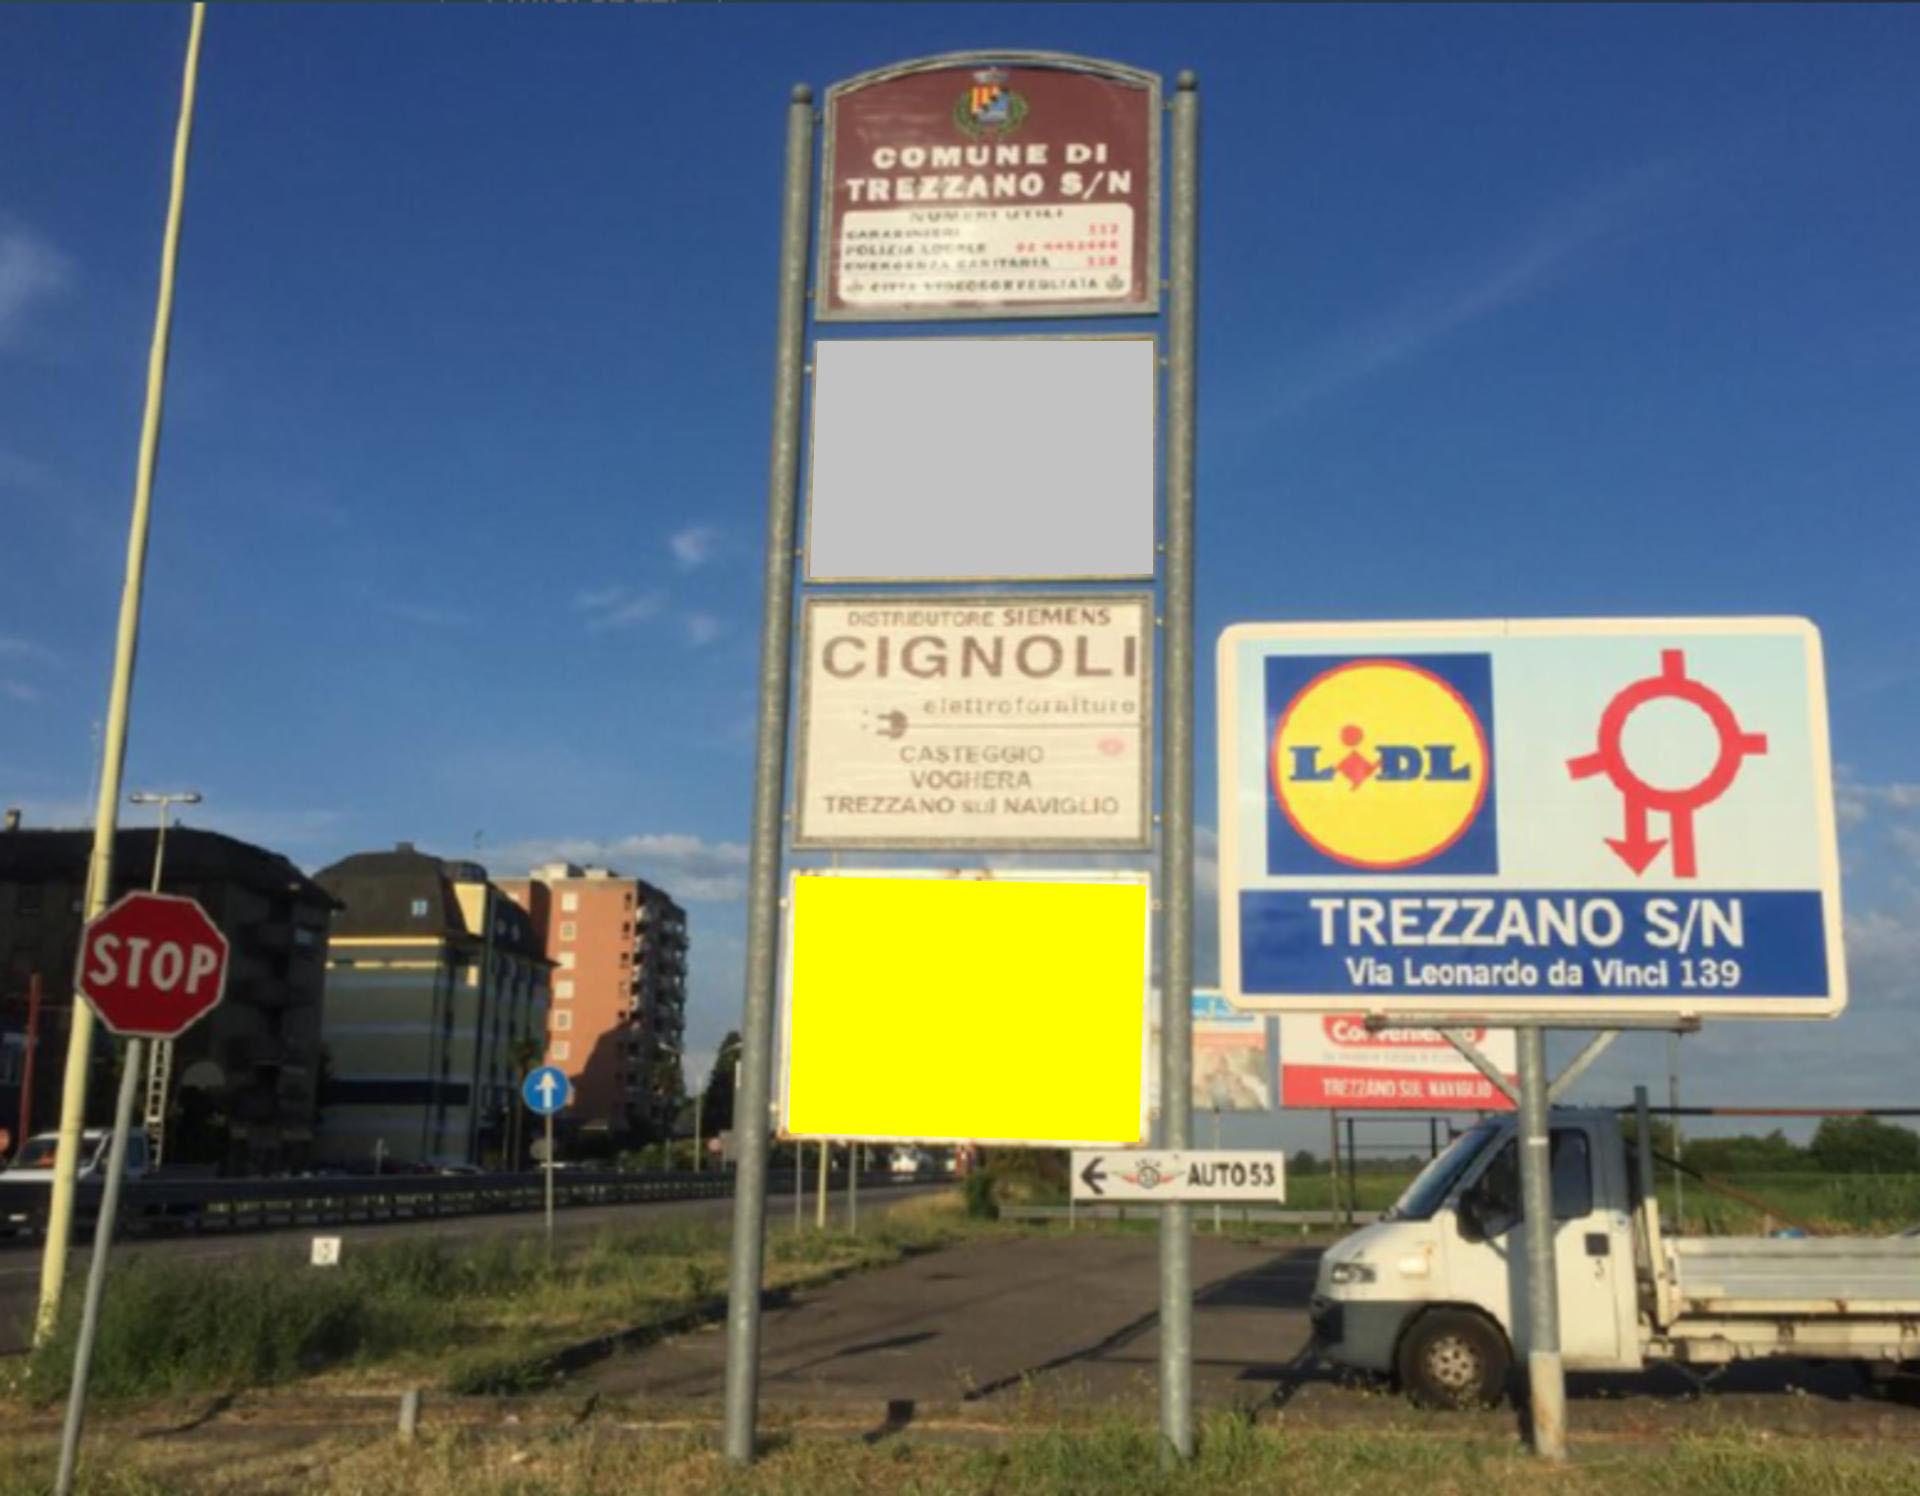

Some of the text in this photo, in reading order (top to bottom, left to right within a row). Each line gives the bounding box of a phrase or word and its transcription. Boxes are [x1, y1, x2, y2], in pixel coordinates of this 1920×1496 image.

[872, 143, 1108, 169] COMUNE DI
[845, 171, 1131, 202] TREZZANO S/N
[848, 607, 1111, 628] DISTRIBUTORE SIEMENS
[821, 634, 1137, 679] CIGNOLI
[899, 745, 1045, 765] CASTEGGIO
[909, 770, 1032, 790] VOGHERA
[824, 796, 954, 815] TREZZANO
[1003, 796, 1120, 816] NAVIGLIO
[1310, 899, 1744, 953] TREZZANO S/N
[88, 933, 218, 994] STOP
[1347, 958, 1741, 989] Via Leonardo da Vinci 139
